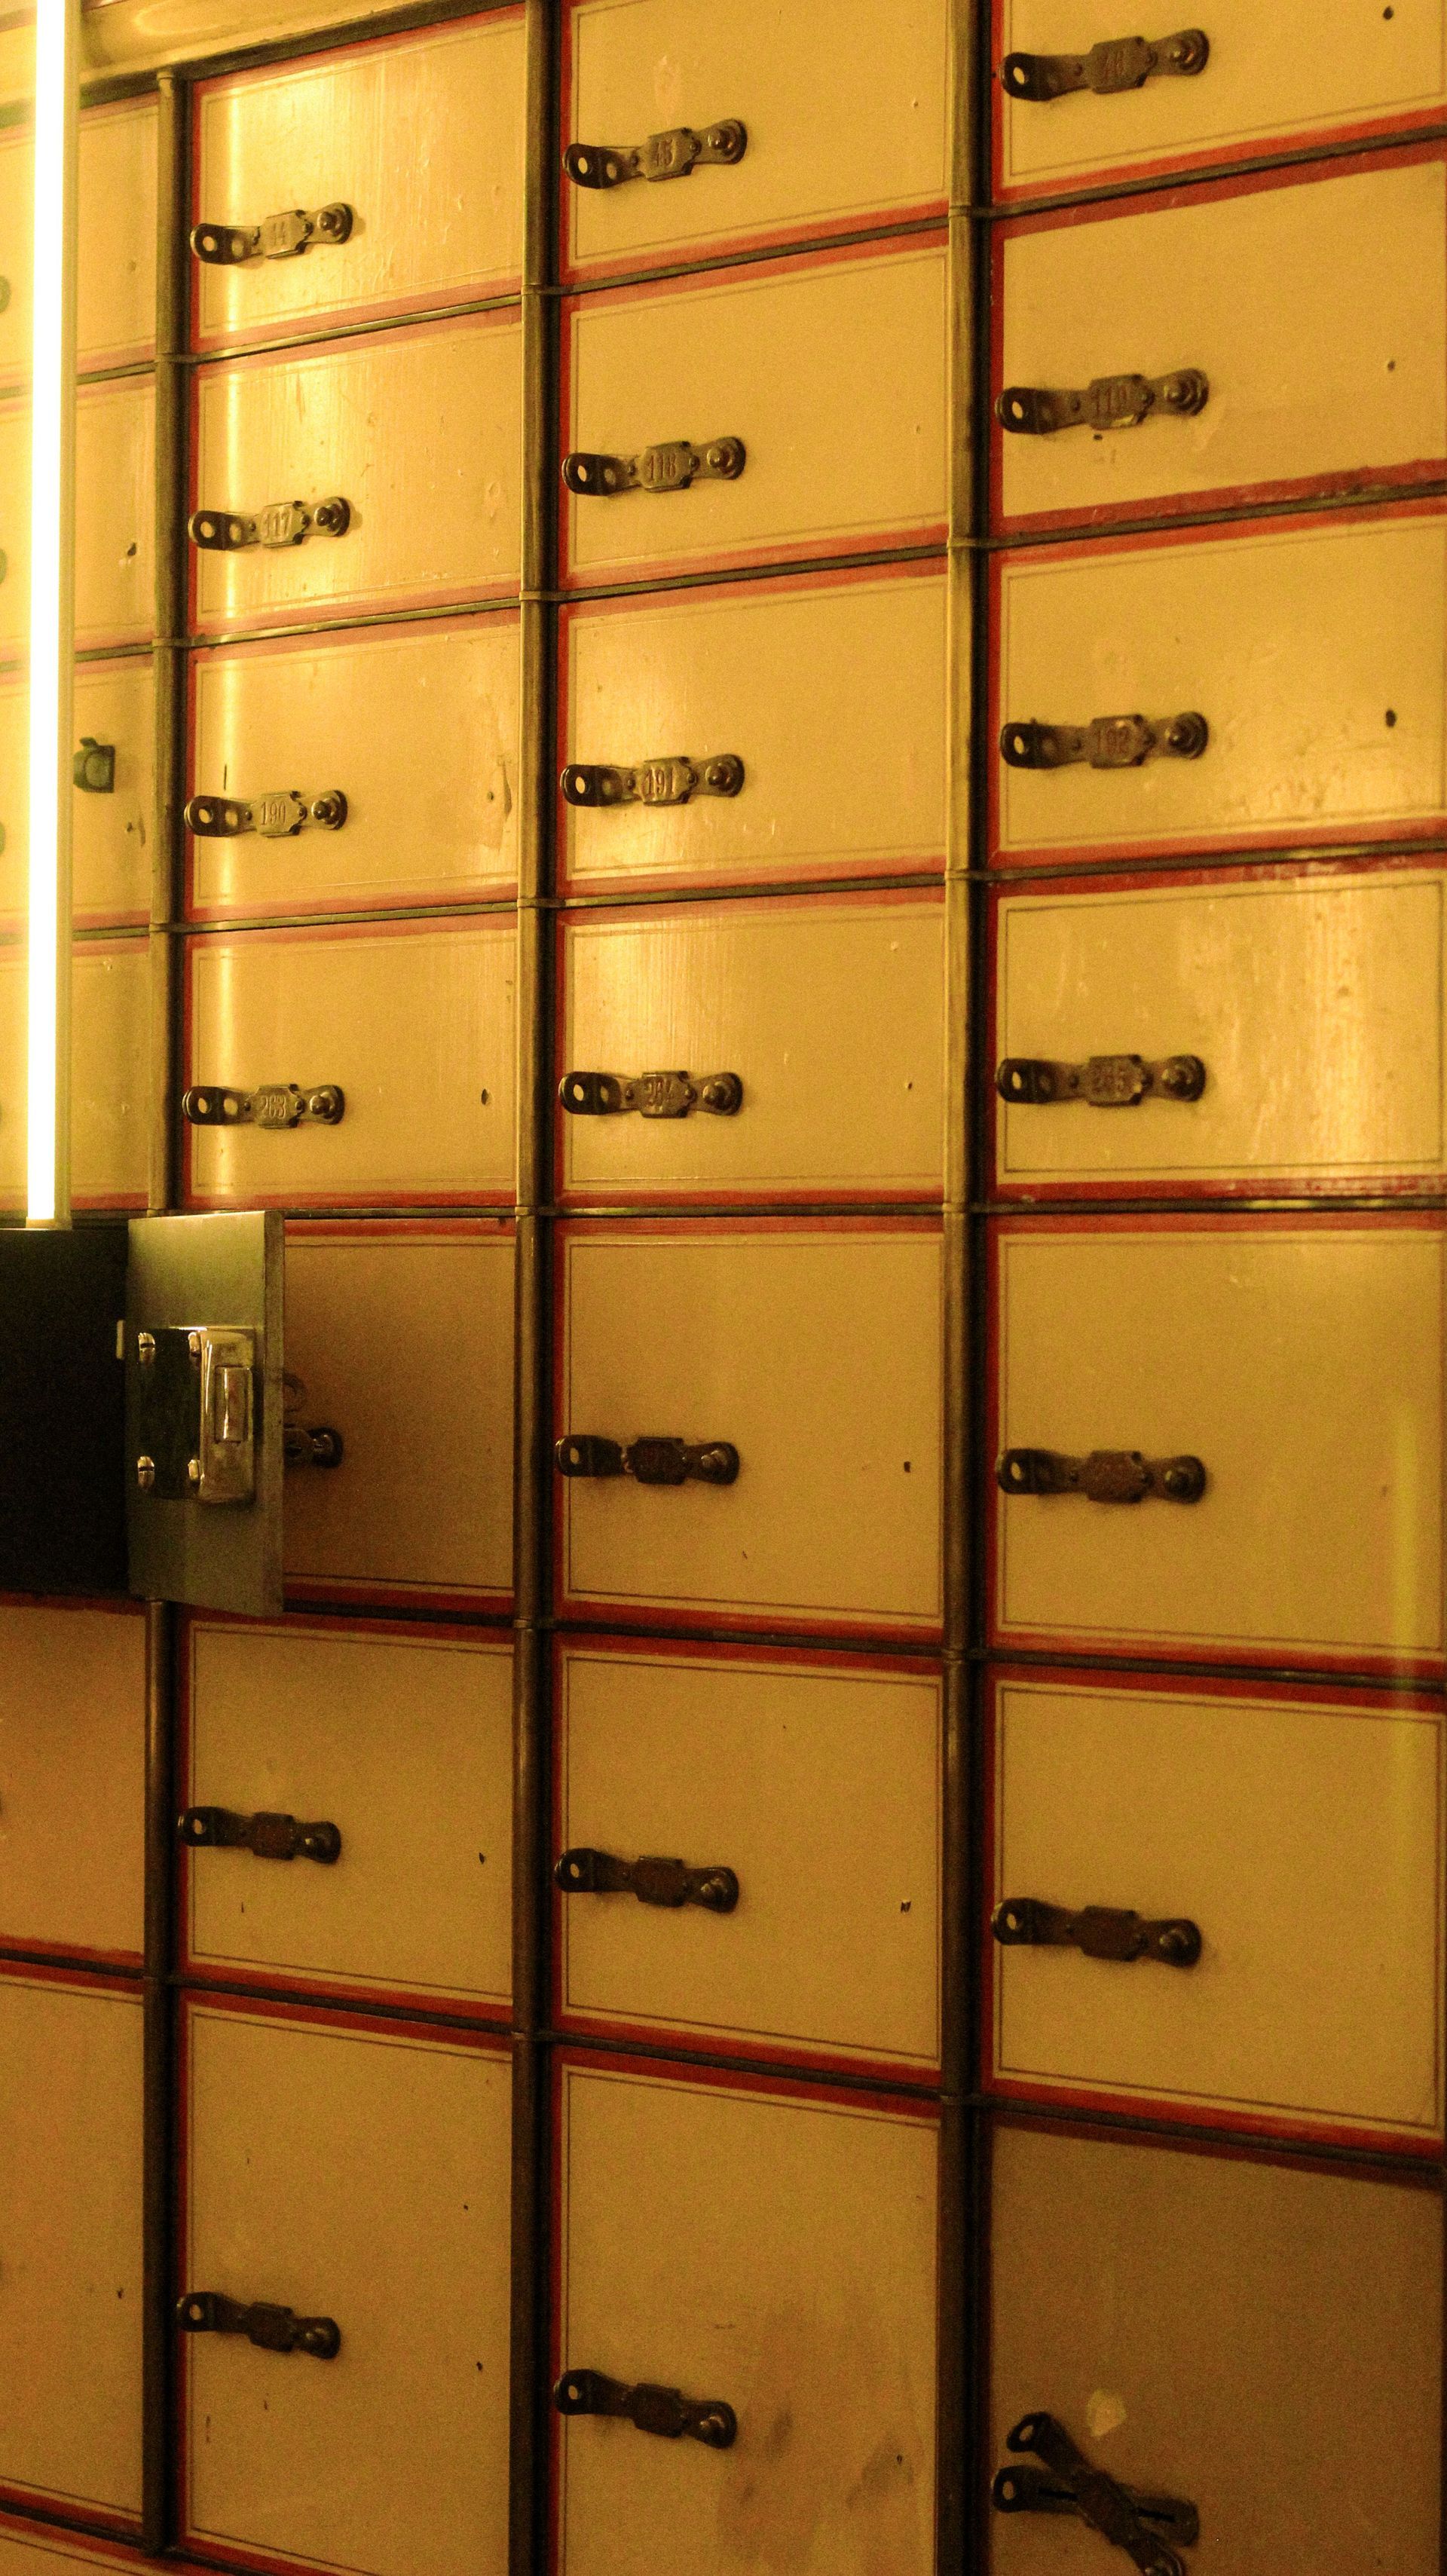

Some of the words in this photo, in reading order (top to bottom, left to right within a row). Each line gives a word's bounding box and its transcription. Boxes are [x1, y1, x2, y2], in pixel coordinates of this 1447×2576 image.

[264, 509, 292, 538] 117
[645, 765, 675, 796] 191
[260, 800, 286, 826] 190
[259, 1094, 286, 1120] 263
